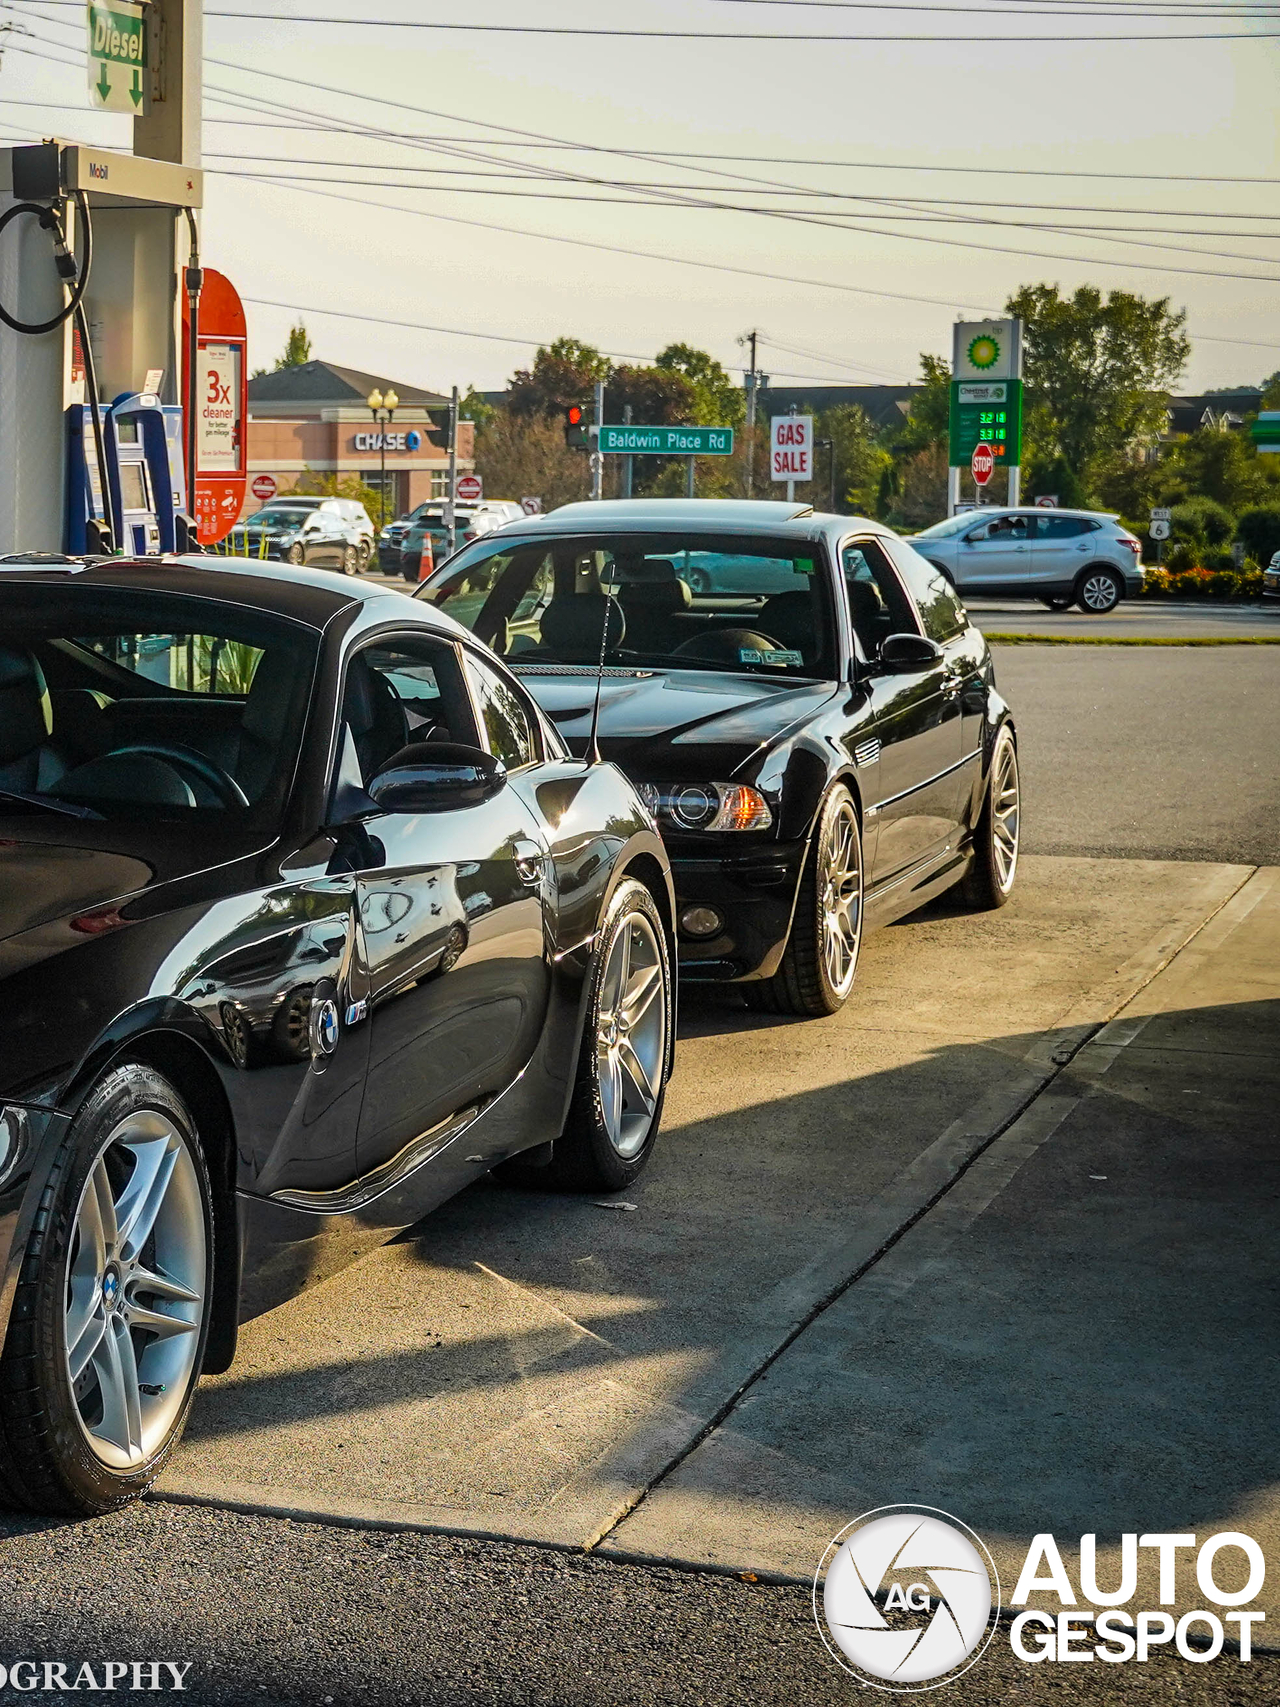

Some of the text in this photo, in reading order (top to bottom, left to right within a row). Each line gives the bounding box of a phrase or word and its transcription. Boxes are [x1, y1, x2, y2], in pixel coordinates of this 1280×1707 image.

[94, 16, 143, 60] Diesel
[89, 162, 109, 180] Mobil
[207, 370, 231, 404] 3x
[202, 405, 234, 418] cleaner
[355, 432, 407, 450] CHASE
[608, 431, 725, 449] Baldwin Place Rd
[776, 424, 805, 446] GAS
[774, 452, 807, 473] SALE
[974, 456, 991, 472] STOP
[1155, 525, 1163, 536] 6
